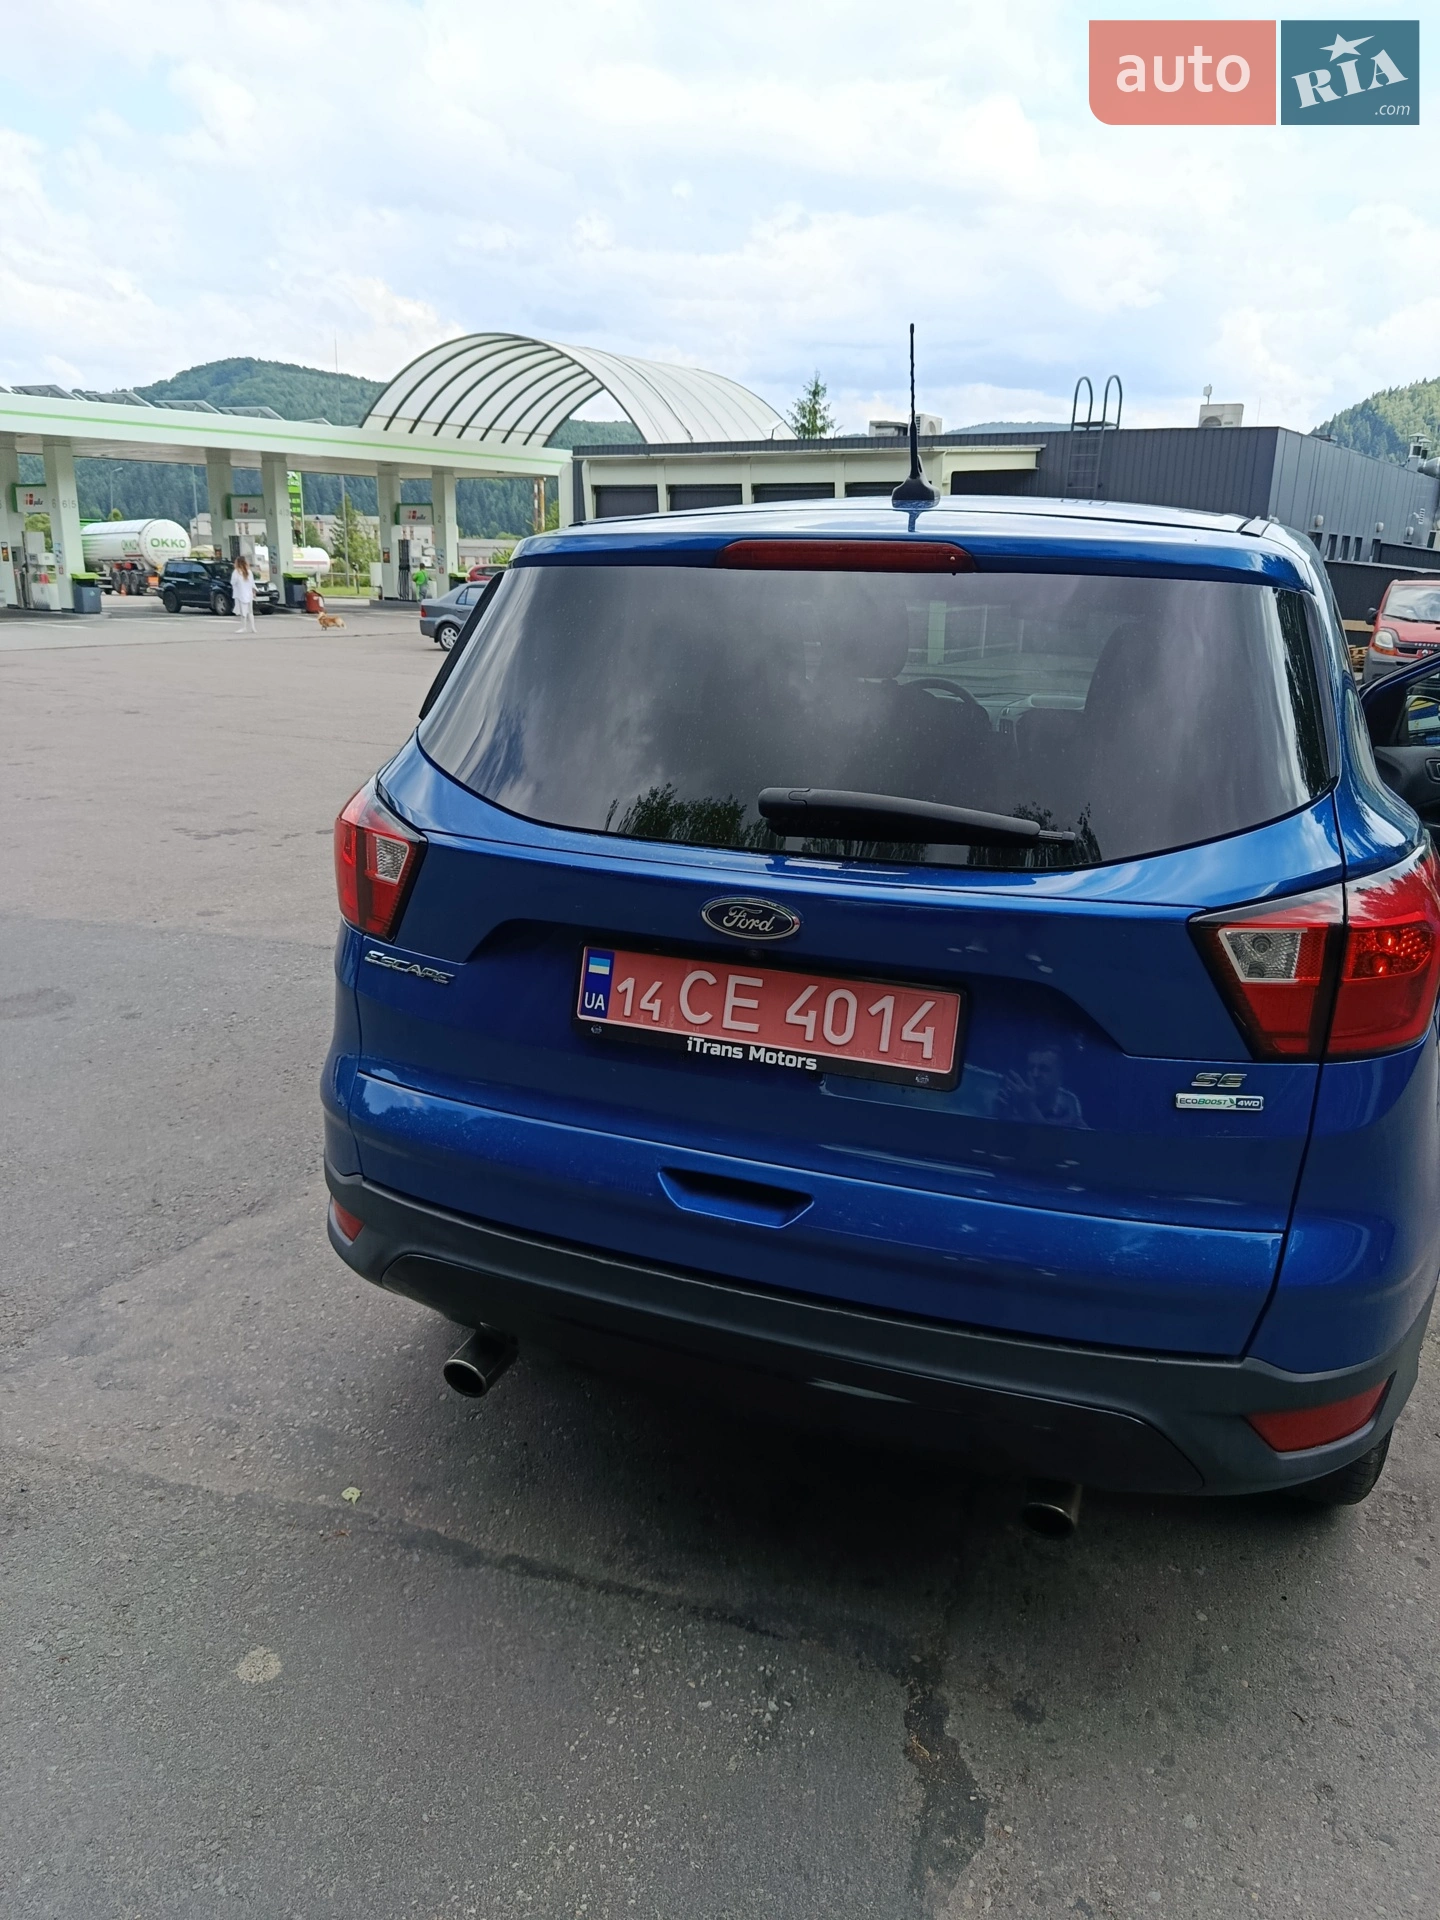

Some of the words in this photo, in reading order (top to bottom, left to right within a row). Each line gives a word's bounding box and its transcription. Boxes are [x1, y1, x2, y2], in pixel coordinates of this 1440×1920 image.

[150, 538, 187, 549] OKKO
[722, 905, 776, 933] Ford
[364, 950, 456, 985] ESCAPE
[584, 991, 606, 1011] UA
[616, 977, 664, 1021] 14
[678, 969, 765, 1034] CE
[784, 984, 937, 1060] 4014
[686, 1036, 743, 1060] iTrans
[748, 1045, 817, 1071] Motors
[1190, 1072, 1248, 1088] SE
[1179, 1097, 1228, 1106] ECOBOOST
